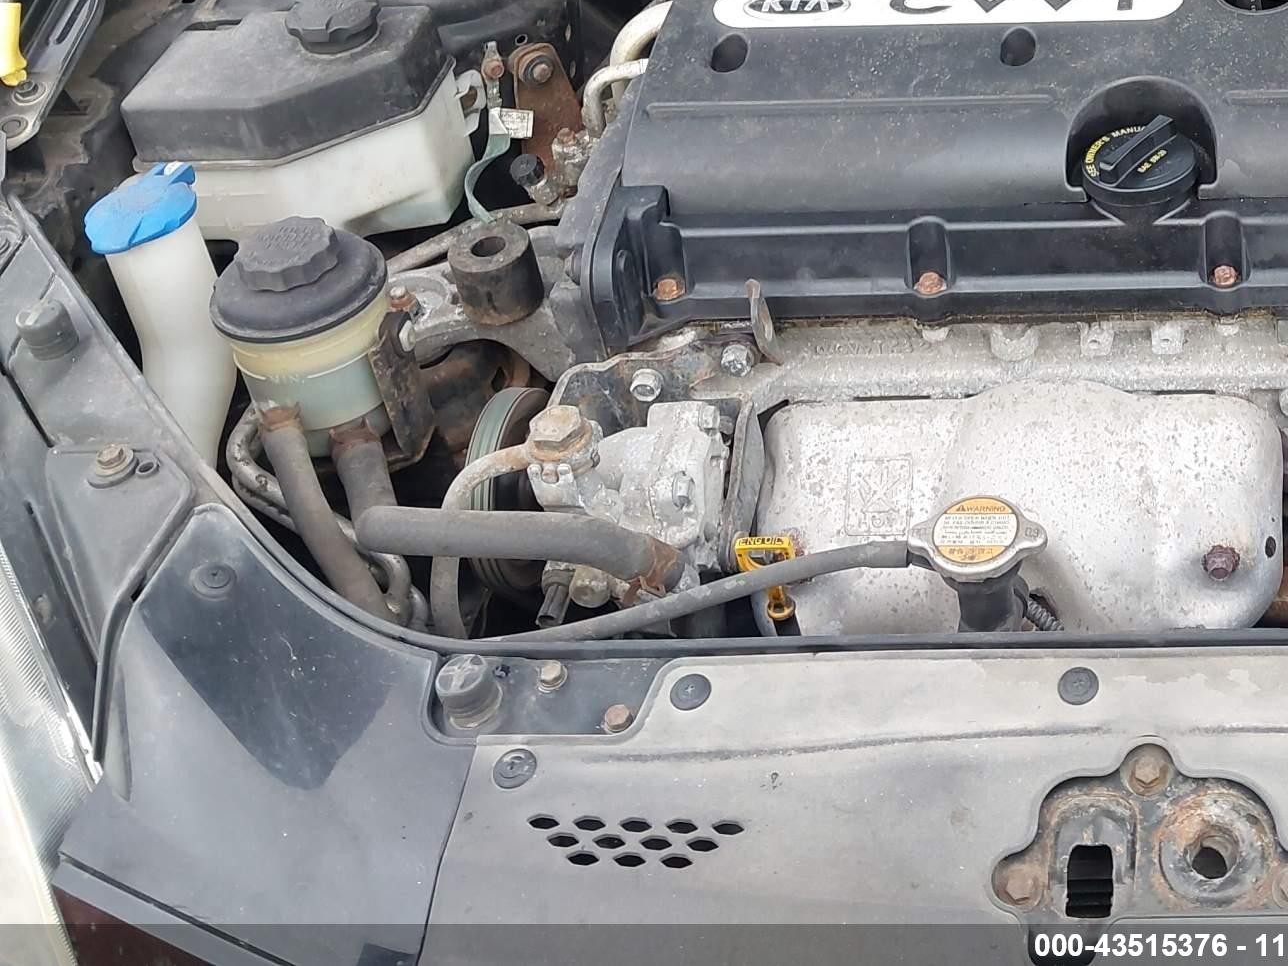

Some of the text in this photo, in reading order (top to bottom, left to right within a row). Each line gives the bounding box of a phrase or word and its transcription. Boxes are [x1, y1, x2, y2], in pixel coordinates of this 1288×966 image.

[966, 505, 1006, 513] WARNING
[738, 537, 784, 546] ENG OIL
